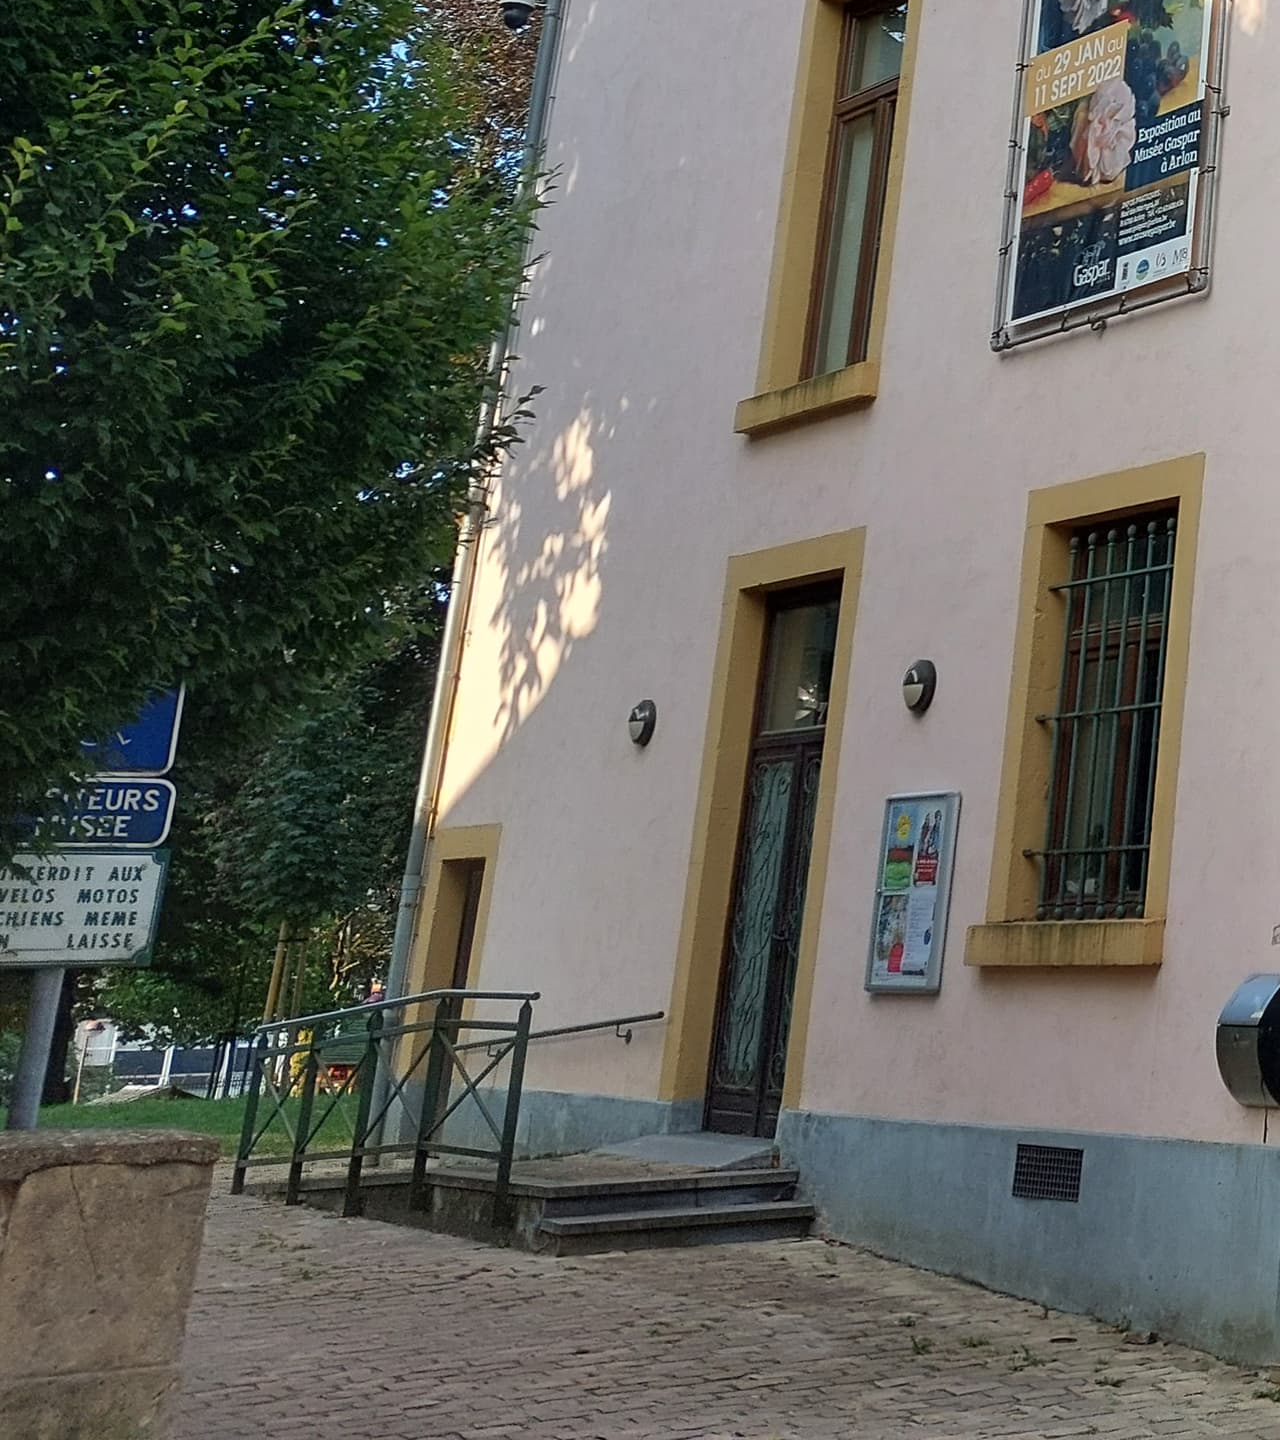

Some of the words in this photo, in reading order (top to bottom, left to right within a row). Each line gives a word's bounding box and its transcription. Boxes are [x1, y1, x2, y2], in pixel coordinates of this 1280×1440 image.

[1053, 49, 1071, 75] 29
[1074, 35, 1105, 66] JAN
[1107, 36, 1123, 53] au
[1035, 84, 1047, 108] 11
[1050, 69, 1085, 101] SEPT
[1087, 55, 1121, 87] 2022
[1138, 115, 1187, 144] Exposition
[1187, 108, 1201, 124] au
[1133, 139, 1164, 164] Musée
[1164, 129, 1200, 152] Gaspar
[1160, 157, 1168, 173] à
[1168, 150, 1198, 171] Arlon
[1073, 258, 1110, 287] Gaspar
[108, 867, 143, 882] AUX
[77, 888, 140, 904] MOTOS
[84, 911, 138, 927] MEME
[66, 933, 134, 949] LAISSE
